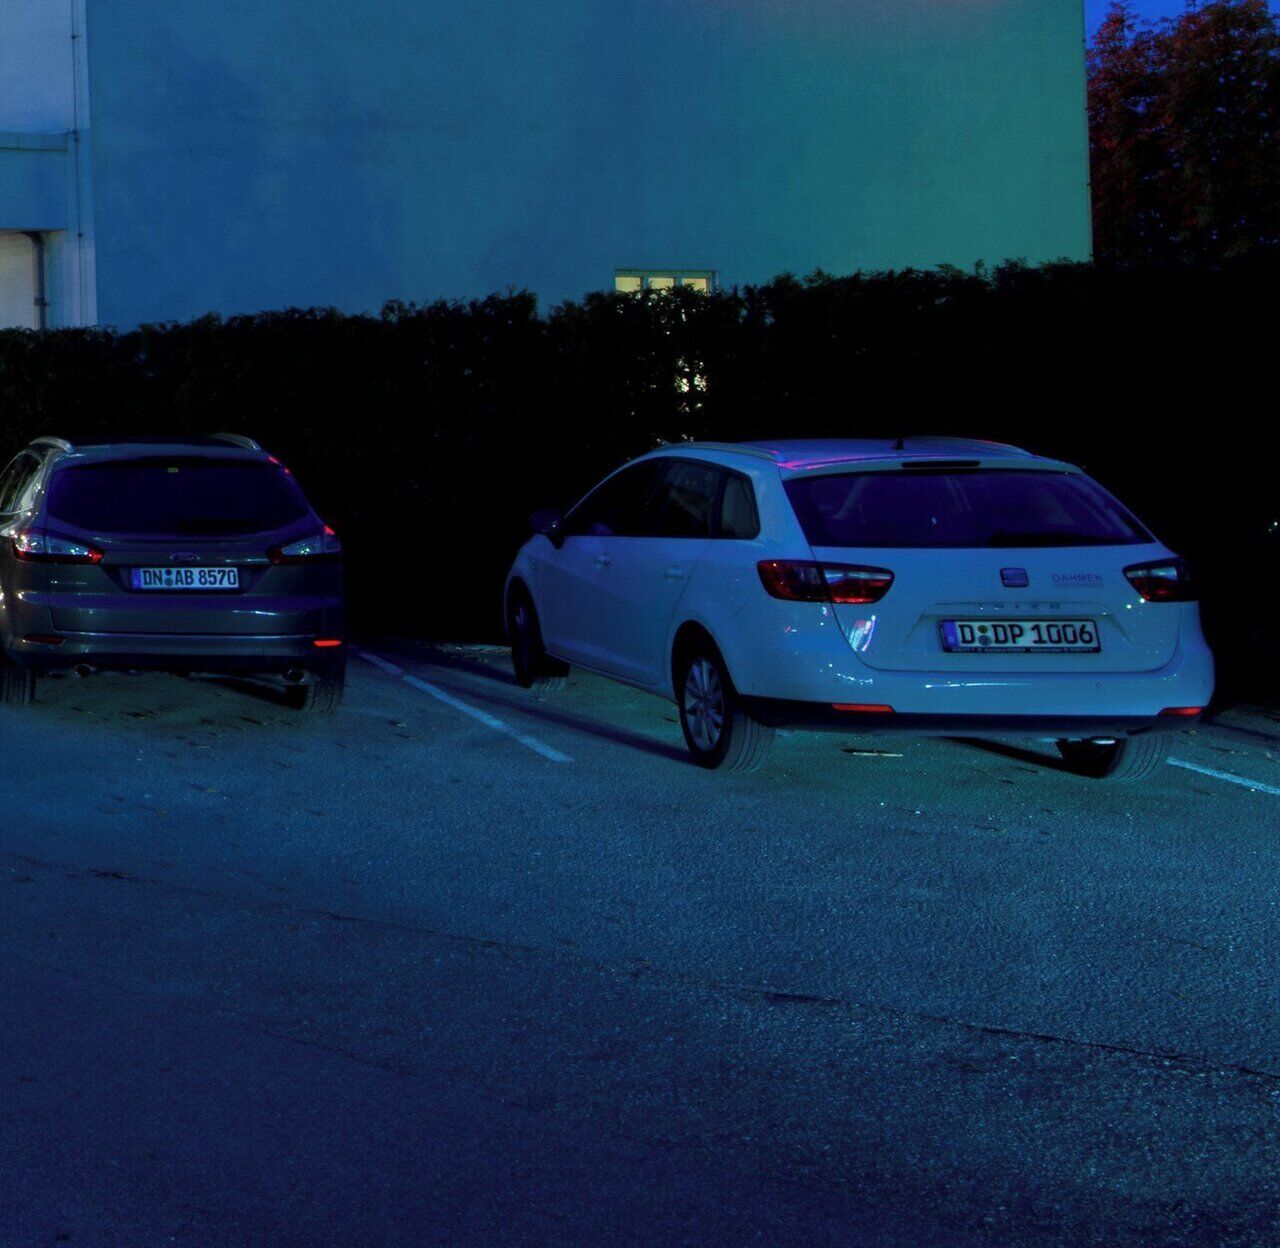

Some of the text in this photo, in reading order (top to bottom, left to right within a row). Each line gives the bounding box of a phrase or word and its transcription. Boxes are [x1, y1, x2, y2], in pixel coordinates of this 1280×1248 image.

[143, 570, 237, 585] DN AB 8570
[959, 623, 1093, 644] D DP 1006
